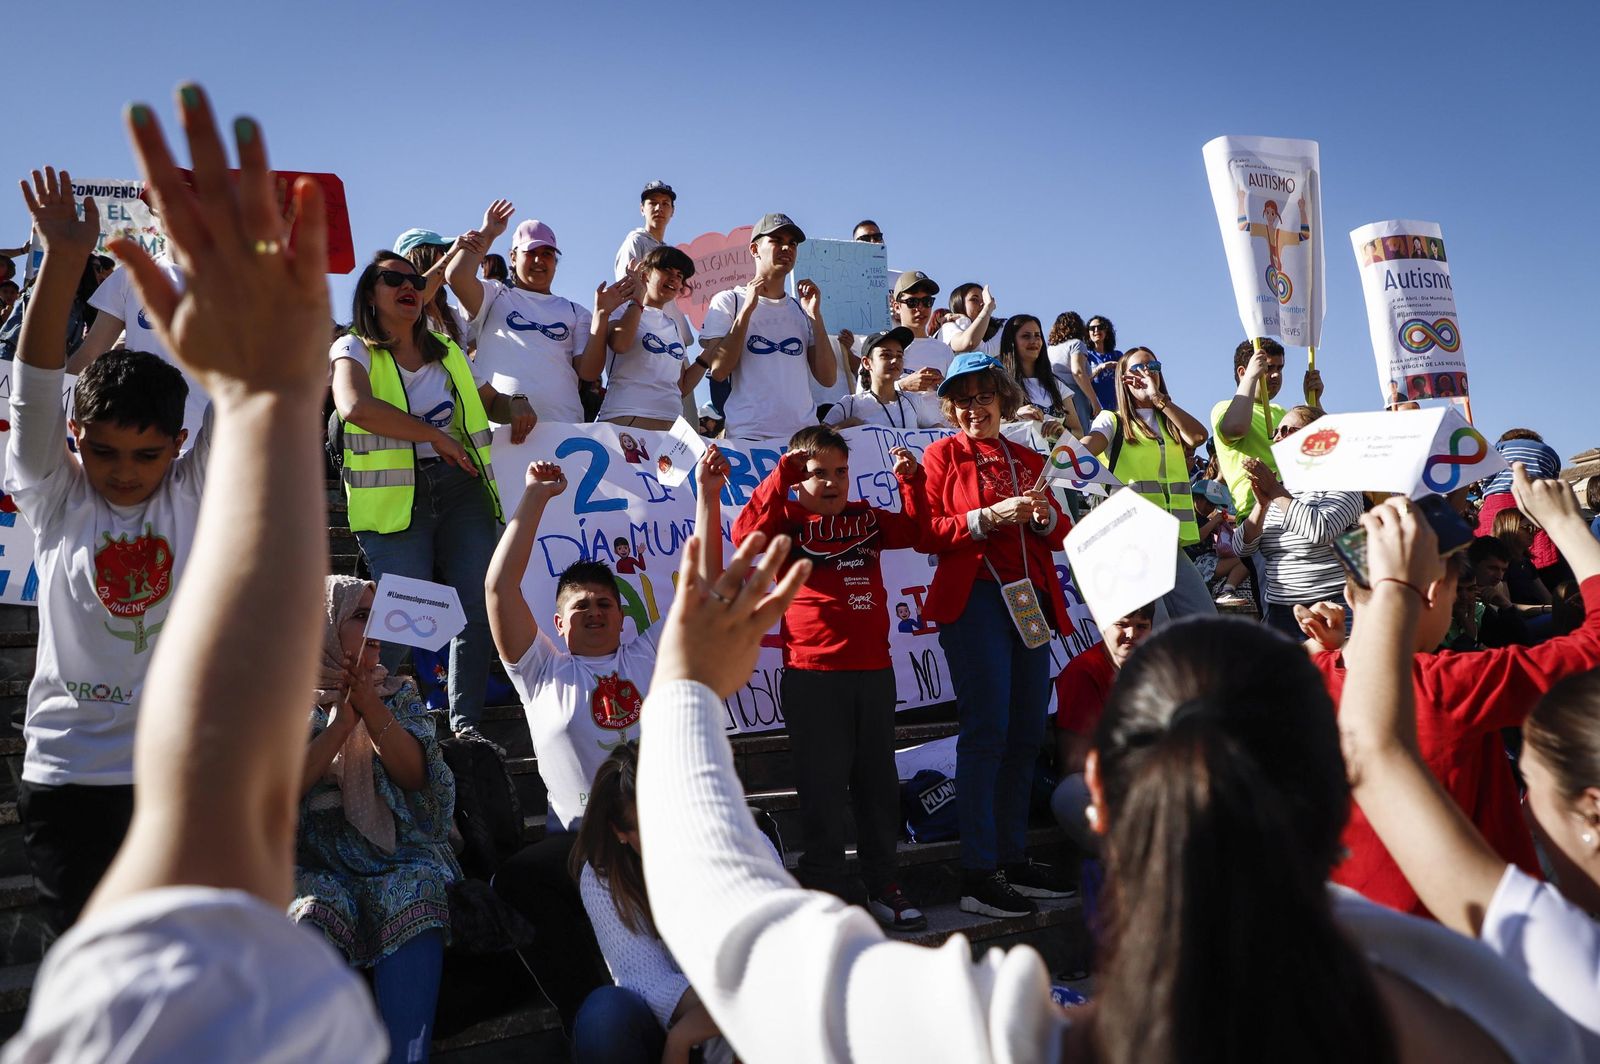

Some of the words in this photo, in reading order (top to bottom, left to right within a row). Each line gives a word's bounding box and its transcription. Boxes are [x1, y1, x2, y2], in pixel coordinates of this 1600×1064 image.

[71, 184, 144, 199] CONVIVENCI
[1249, 172, 1295, 194] AUTISMO
[108, 204, 131, 221] EL
[555, 437, 628, 514] 2
[799, 509, 877, 546] JUMP
[909, 648, 942, 701] NO
[921, 781, 955, 807] MUN
